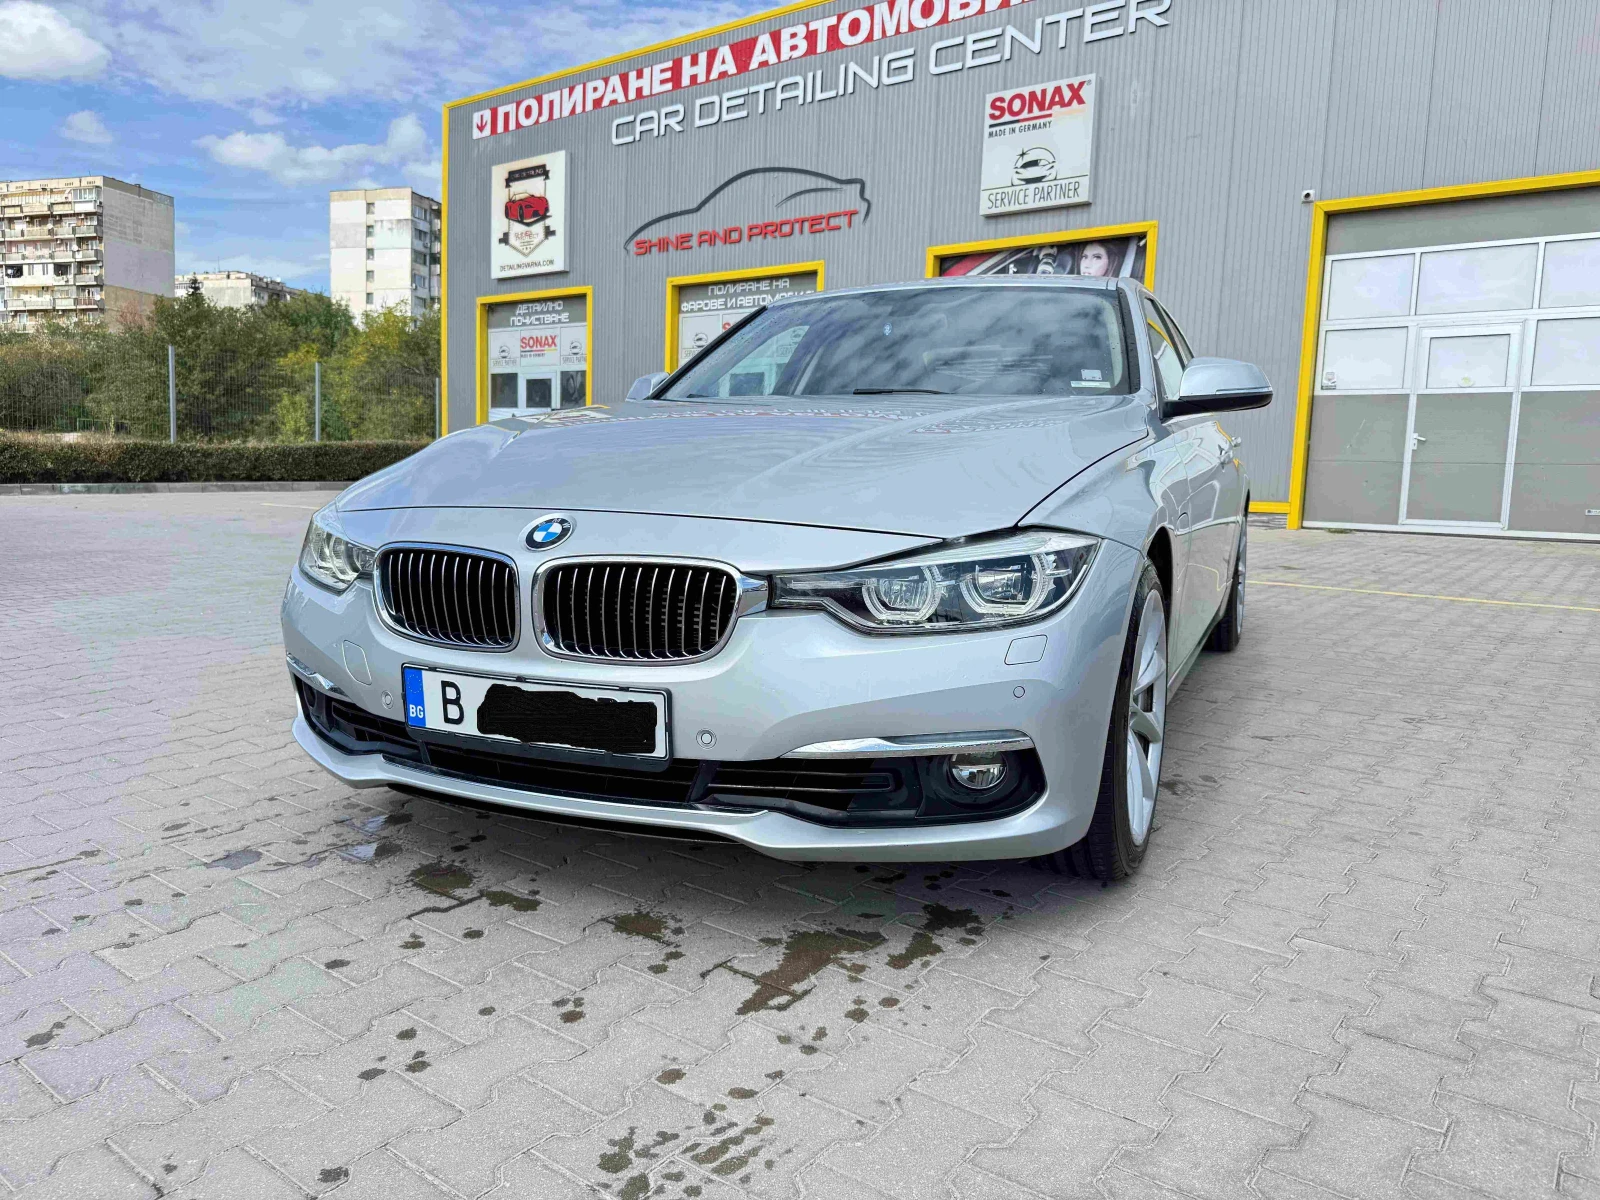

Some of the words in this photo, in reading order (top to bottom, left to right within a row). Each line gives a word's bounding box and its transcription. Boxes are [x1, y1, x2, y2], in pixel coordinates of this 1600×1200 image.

[611, 103, 685, 145] CAR
[694, 48, 915, 128] DETAILING
[929, 0, 1172, 75] CENTER
[497, 61, 673, 134] ПОЛИРАНЕ
[681, 45, 737, 88] НА
[989, 81, 1086, 121] SONAX
[988, 129, 1006, 138] MADE
[1008, 127, 1016, 135] IN
[1018, 121, 1052, 133] GERMANY
[987, 188, 1029, 210] SERVICE
[1033, 181, 1080, 203] PARTNER
[634, 233, 693, 255] SHINE
[697, 226, 742, 247] AND
[747, 209, 858, 242] PROTECT
[708, 280, 770, 296] ПОЛИРАНЕ
[773, 278, 789, 290] НА
[681, 300, 725, 312] ФАРОВЕ
[727, 299, 736, 309] И
[510, 312, 569, 326] ПОЧИСТВАНЕ
[521, 335, 557, 349] SONAX
[409, 703, 424, 719] BG
